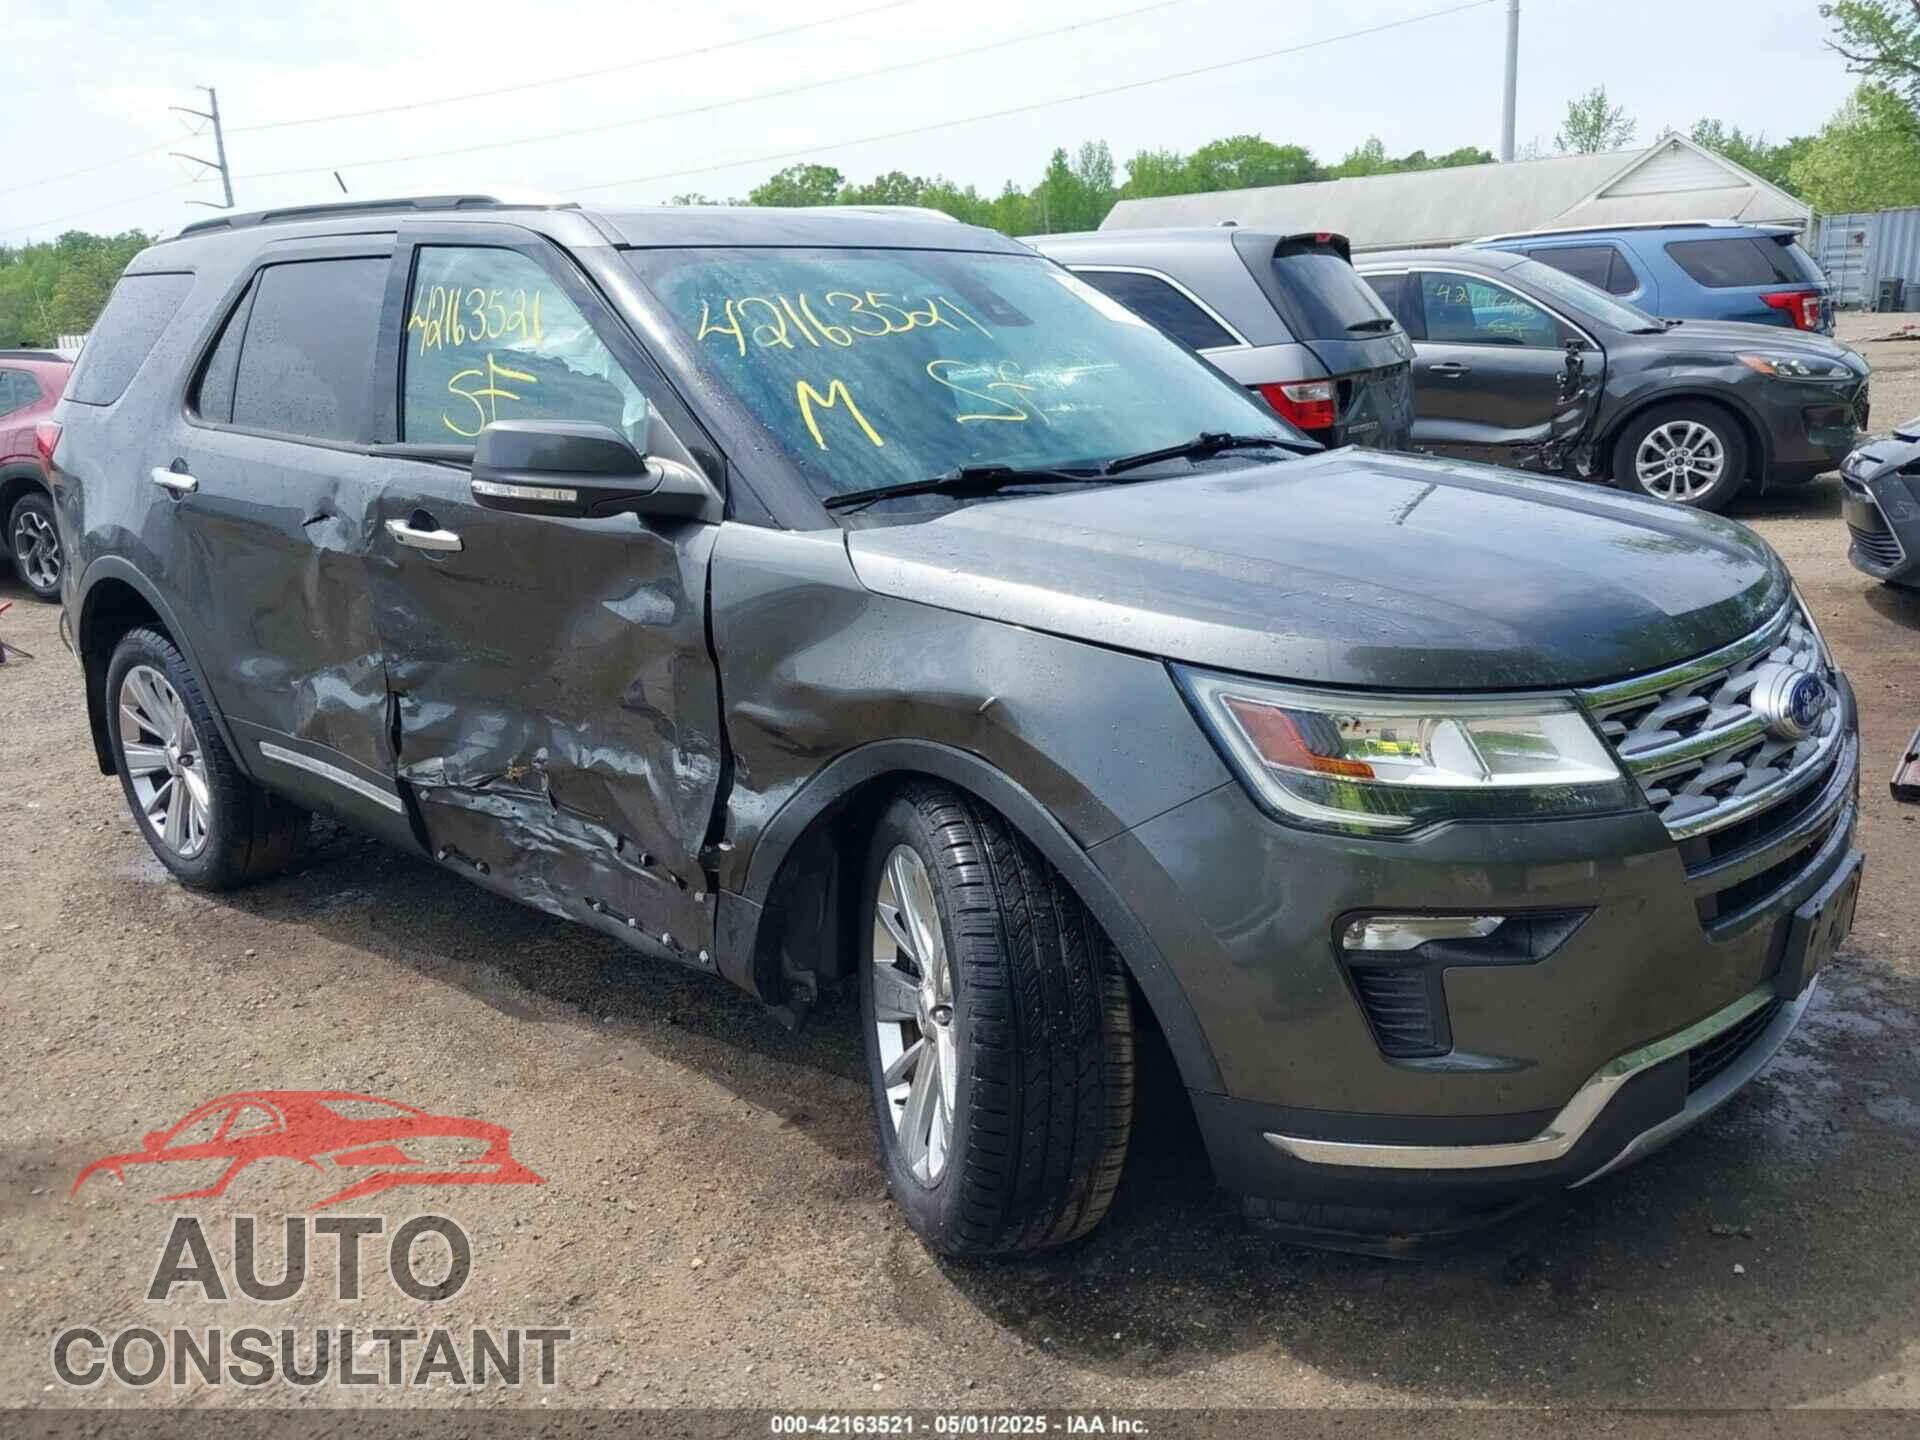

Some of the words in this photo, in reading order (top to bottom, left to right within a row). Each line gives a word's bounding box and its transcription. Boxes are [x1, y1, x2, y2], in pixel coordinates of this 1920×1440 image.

[407, 284, 545, 357] 42163521
[697, 292, 994, 357] 42163521
[796, 379, 885, 451] M
